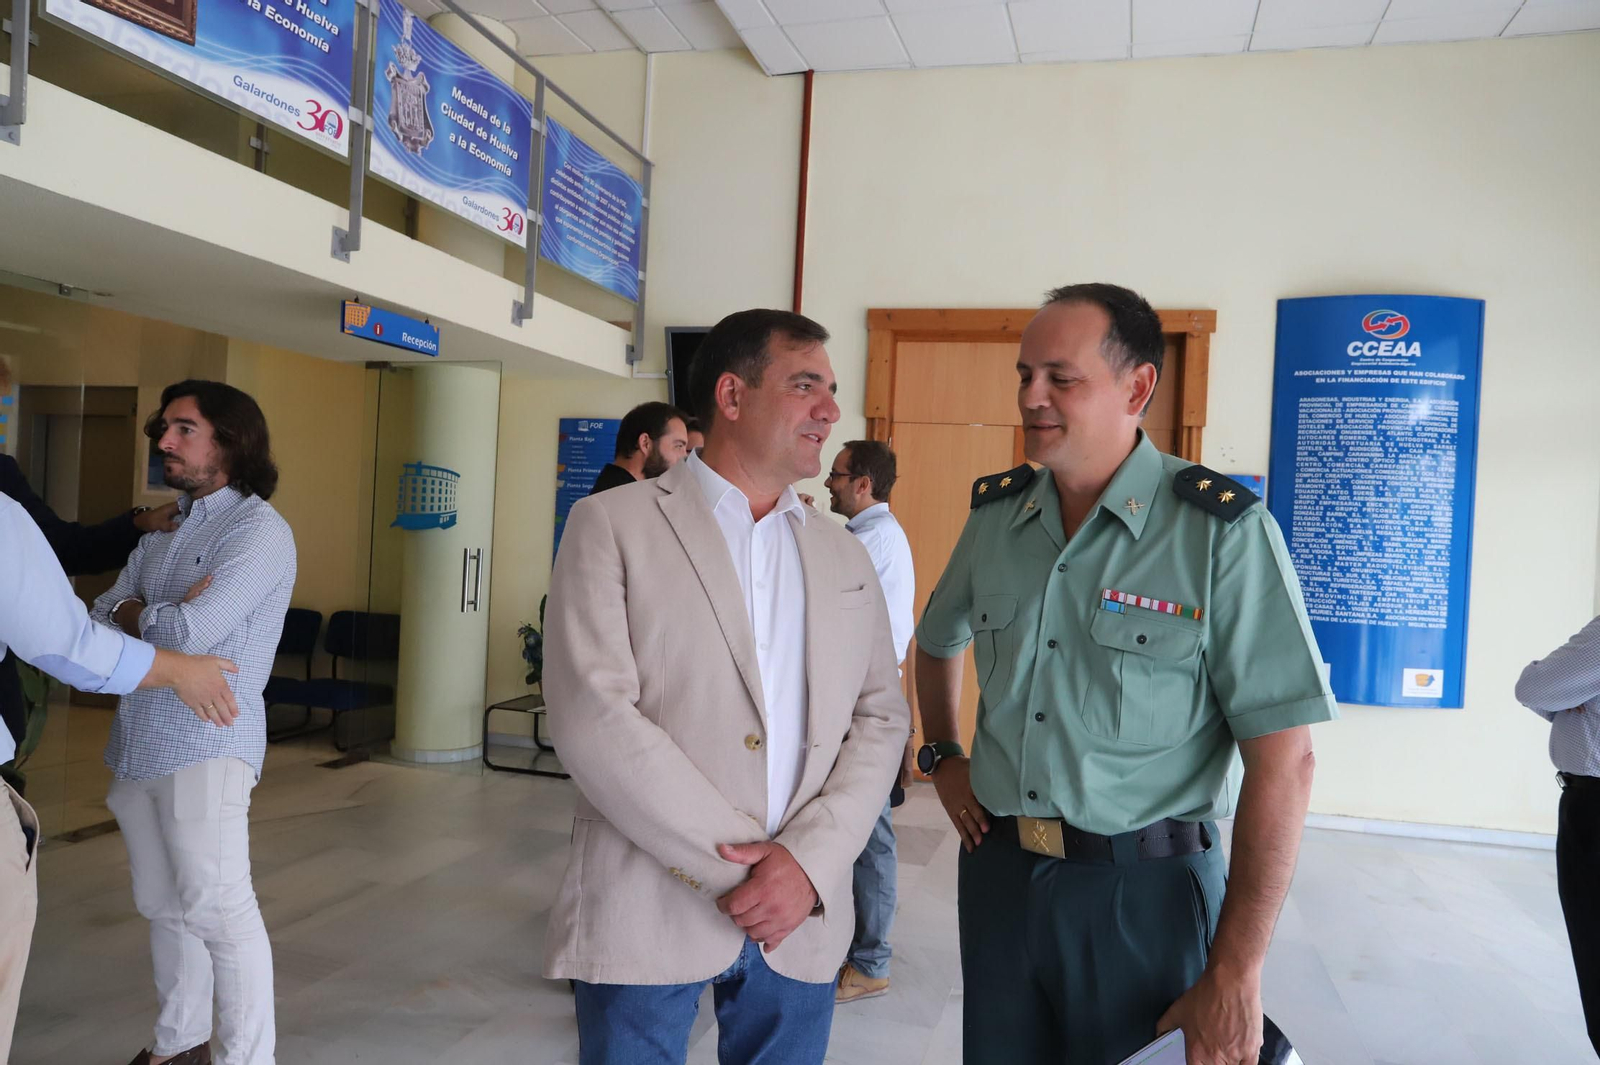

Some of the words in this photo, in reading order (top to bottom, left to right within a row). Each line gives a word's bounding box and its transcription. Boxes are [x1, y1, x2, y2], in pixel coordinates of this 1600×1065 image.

[265, 5, 330, 52] Economía
[296, 3, 338, 35] Huelva
[233, 75, 300, 117] Galardones
[452, 87, 488, 119] Medalla
[490, 113, 501, 128] de
[503, 121, 511, 135] la
[297, 100, 343, 139] 30
[441, 102, 474, 131] Ciudad
[476, 125, 487, 140] de
[490, 134, 518, 160] Huelva
[450, 133, 455, 142] a
[458, 138, 466, 149] la
[469, 144, 511, 176] Economía
[462, 196, 499, 222] Galardones
[497, 207, 523, 235] 30
[402, 332, 436, 351] Recepción
[1347, 341, 1421, 357] CCEAA
[1425, 372, 1465, 380] COLABORADO
